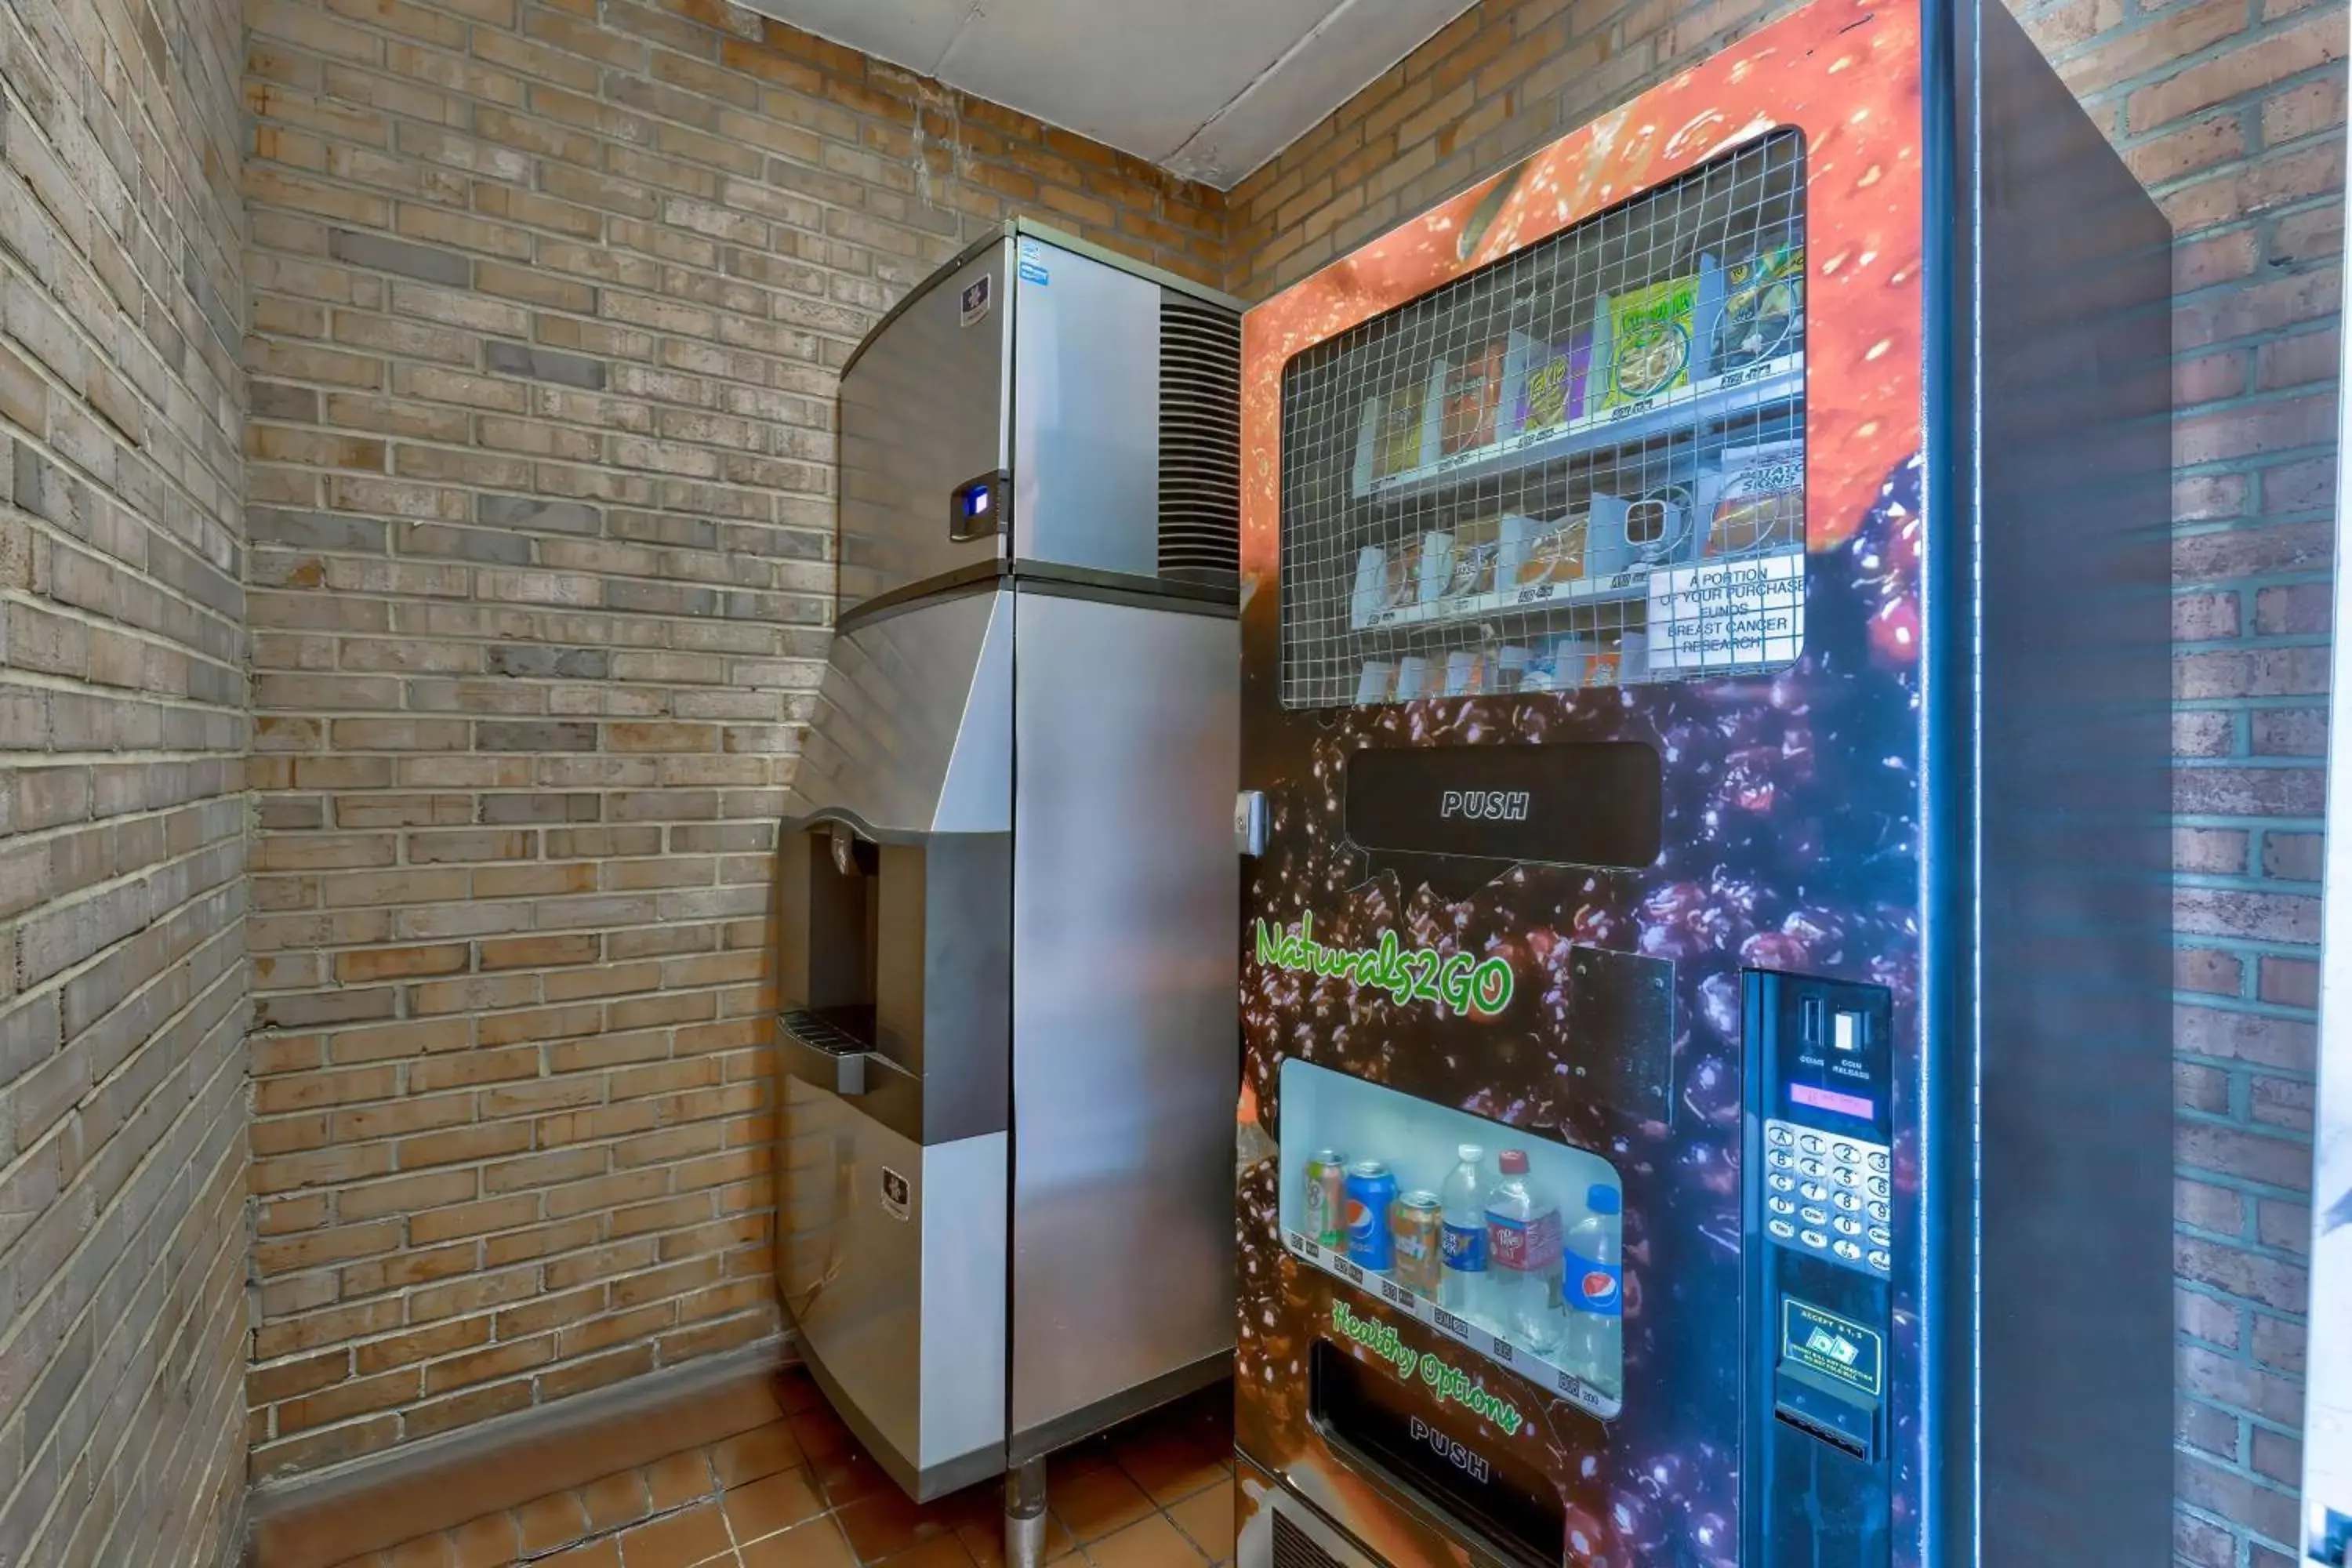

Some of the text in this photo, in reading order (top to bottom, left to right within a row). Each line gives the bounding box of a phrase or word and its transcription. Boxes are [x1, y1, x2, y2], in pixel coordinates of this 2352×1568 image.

[1690, 568, 1768, 587] A PORTION
[1682, 588, 1722, 604] YOUR
[1727, 581, 1804, 600] PURCHASE
[1700, 603, 1749, 617] FUNDS
[1668, 617, 1788, 638] BREAST CANCER
[1682, 636, 1761, 653] RESEARCH
[1441, 790, 1530, 821] PUSH
[1256, 909, 1514, 1015] Naturals2GO
[1777, 1131, 1787, 1144] A
[1777, 1152, 1786, 1166] B
[1843, 1146, 1852, 1161] 2
[1809, 1161, 1817, 1174] 4
[1878, 1156, 1886, 1169] 3
[1777, 1177, 1786, 1189] C
[1843, 1169, 1852, 1184] 5
[1777, 1199, 1787, 1211] D
[1843, 1195, 1851, 1208] 8
[1843, 1220, 1851, 1232] 0
[1333, 1298, 1523, 1436] Healthy Options
[1410, 1415, 1490, 1484] PUSH
